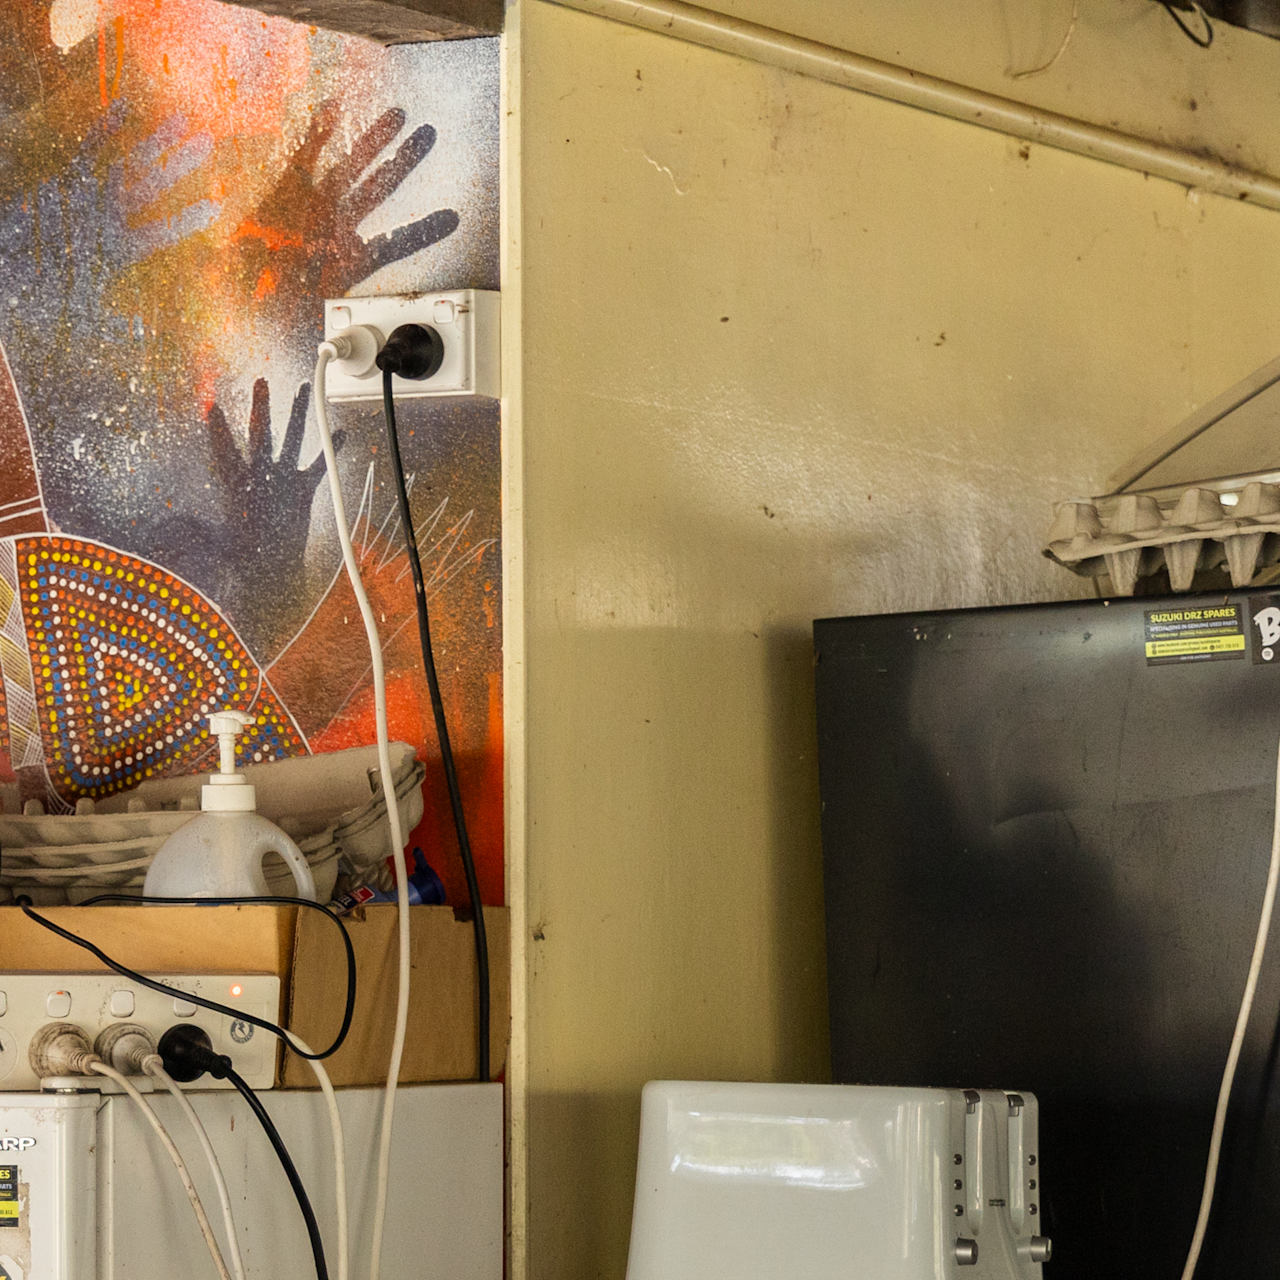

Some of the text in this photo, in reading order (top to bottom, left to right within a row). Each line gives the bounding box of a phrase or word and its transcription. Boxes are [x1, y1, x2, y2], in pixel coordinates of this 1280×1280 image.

[1150, 608, 1236, 623] SUZUKI DRZ SPARES
